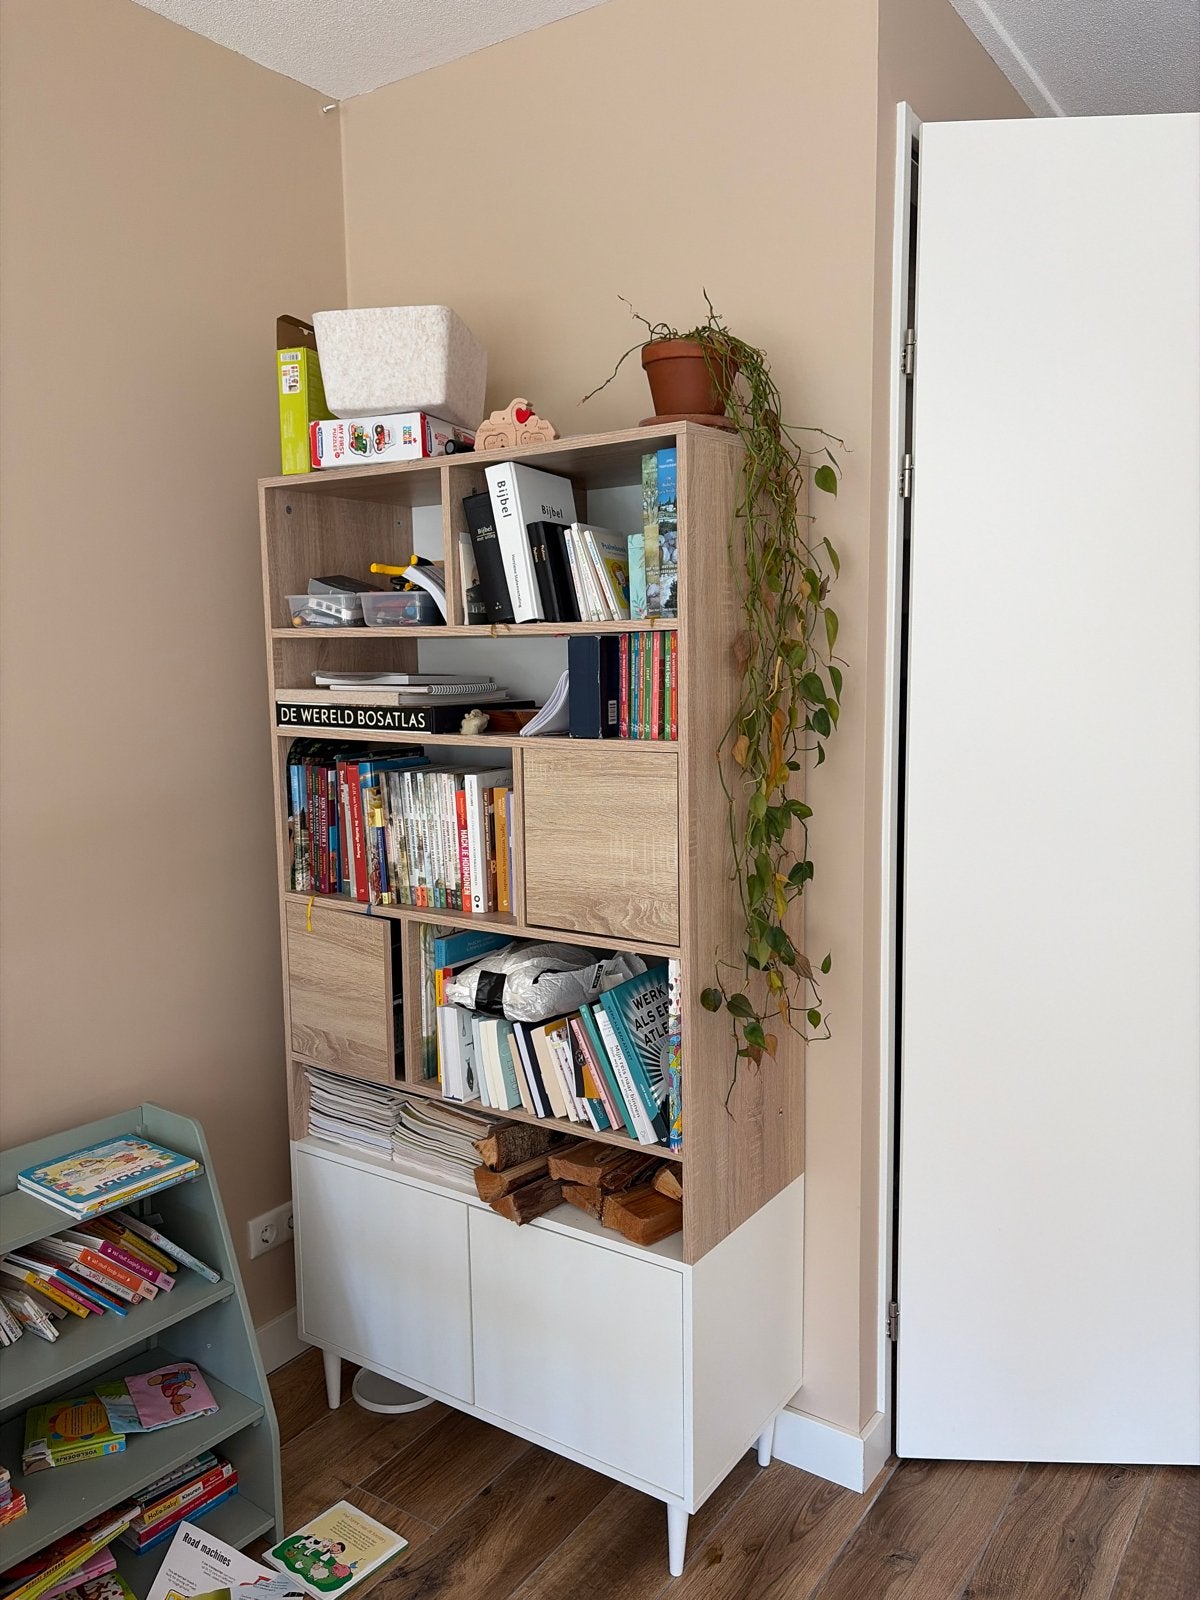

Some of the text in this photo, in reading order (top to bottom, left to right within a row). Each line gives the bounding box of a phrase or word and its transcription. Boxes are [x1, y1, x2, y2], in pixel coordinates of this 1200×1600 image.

[497, 480, 512, 518] Bijbel
[541, 504, 563, 519] Bijbel
[280, 707, 426, 728] DE WERELD BOSATLAS
[460, 829, 468, 846] HACK
[461, 857, 470, 894] HORMONEN
[632, 984, 667, 1011] WERK
[634, 1010, 656, 1032] ALS
[655, 1001, 670, 1018] EE
[606, 1005, 615, 1020] WERK
[621, 1042, 633, 1061] ATLEET
[613, 1044, 623, 1060] Mijn
[618, 1061, 627, 1075] reis
[623, 1075, 633, 1092] naar
[629, 1093, 642, 1117] binnen
[181, 1486, 202, 1500] Kleuren
[182, 1532, 232, 1567] Road machines
